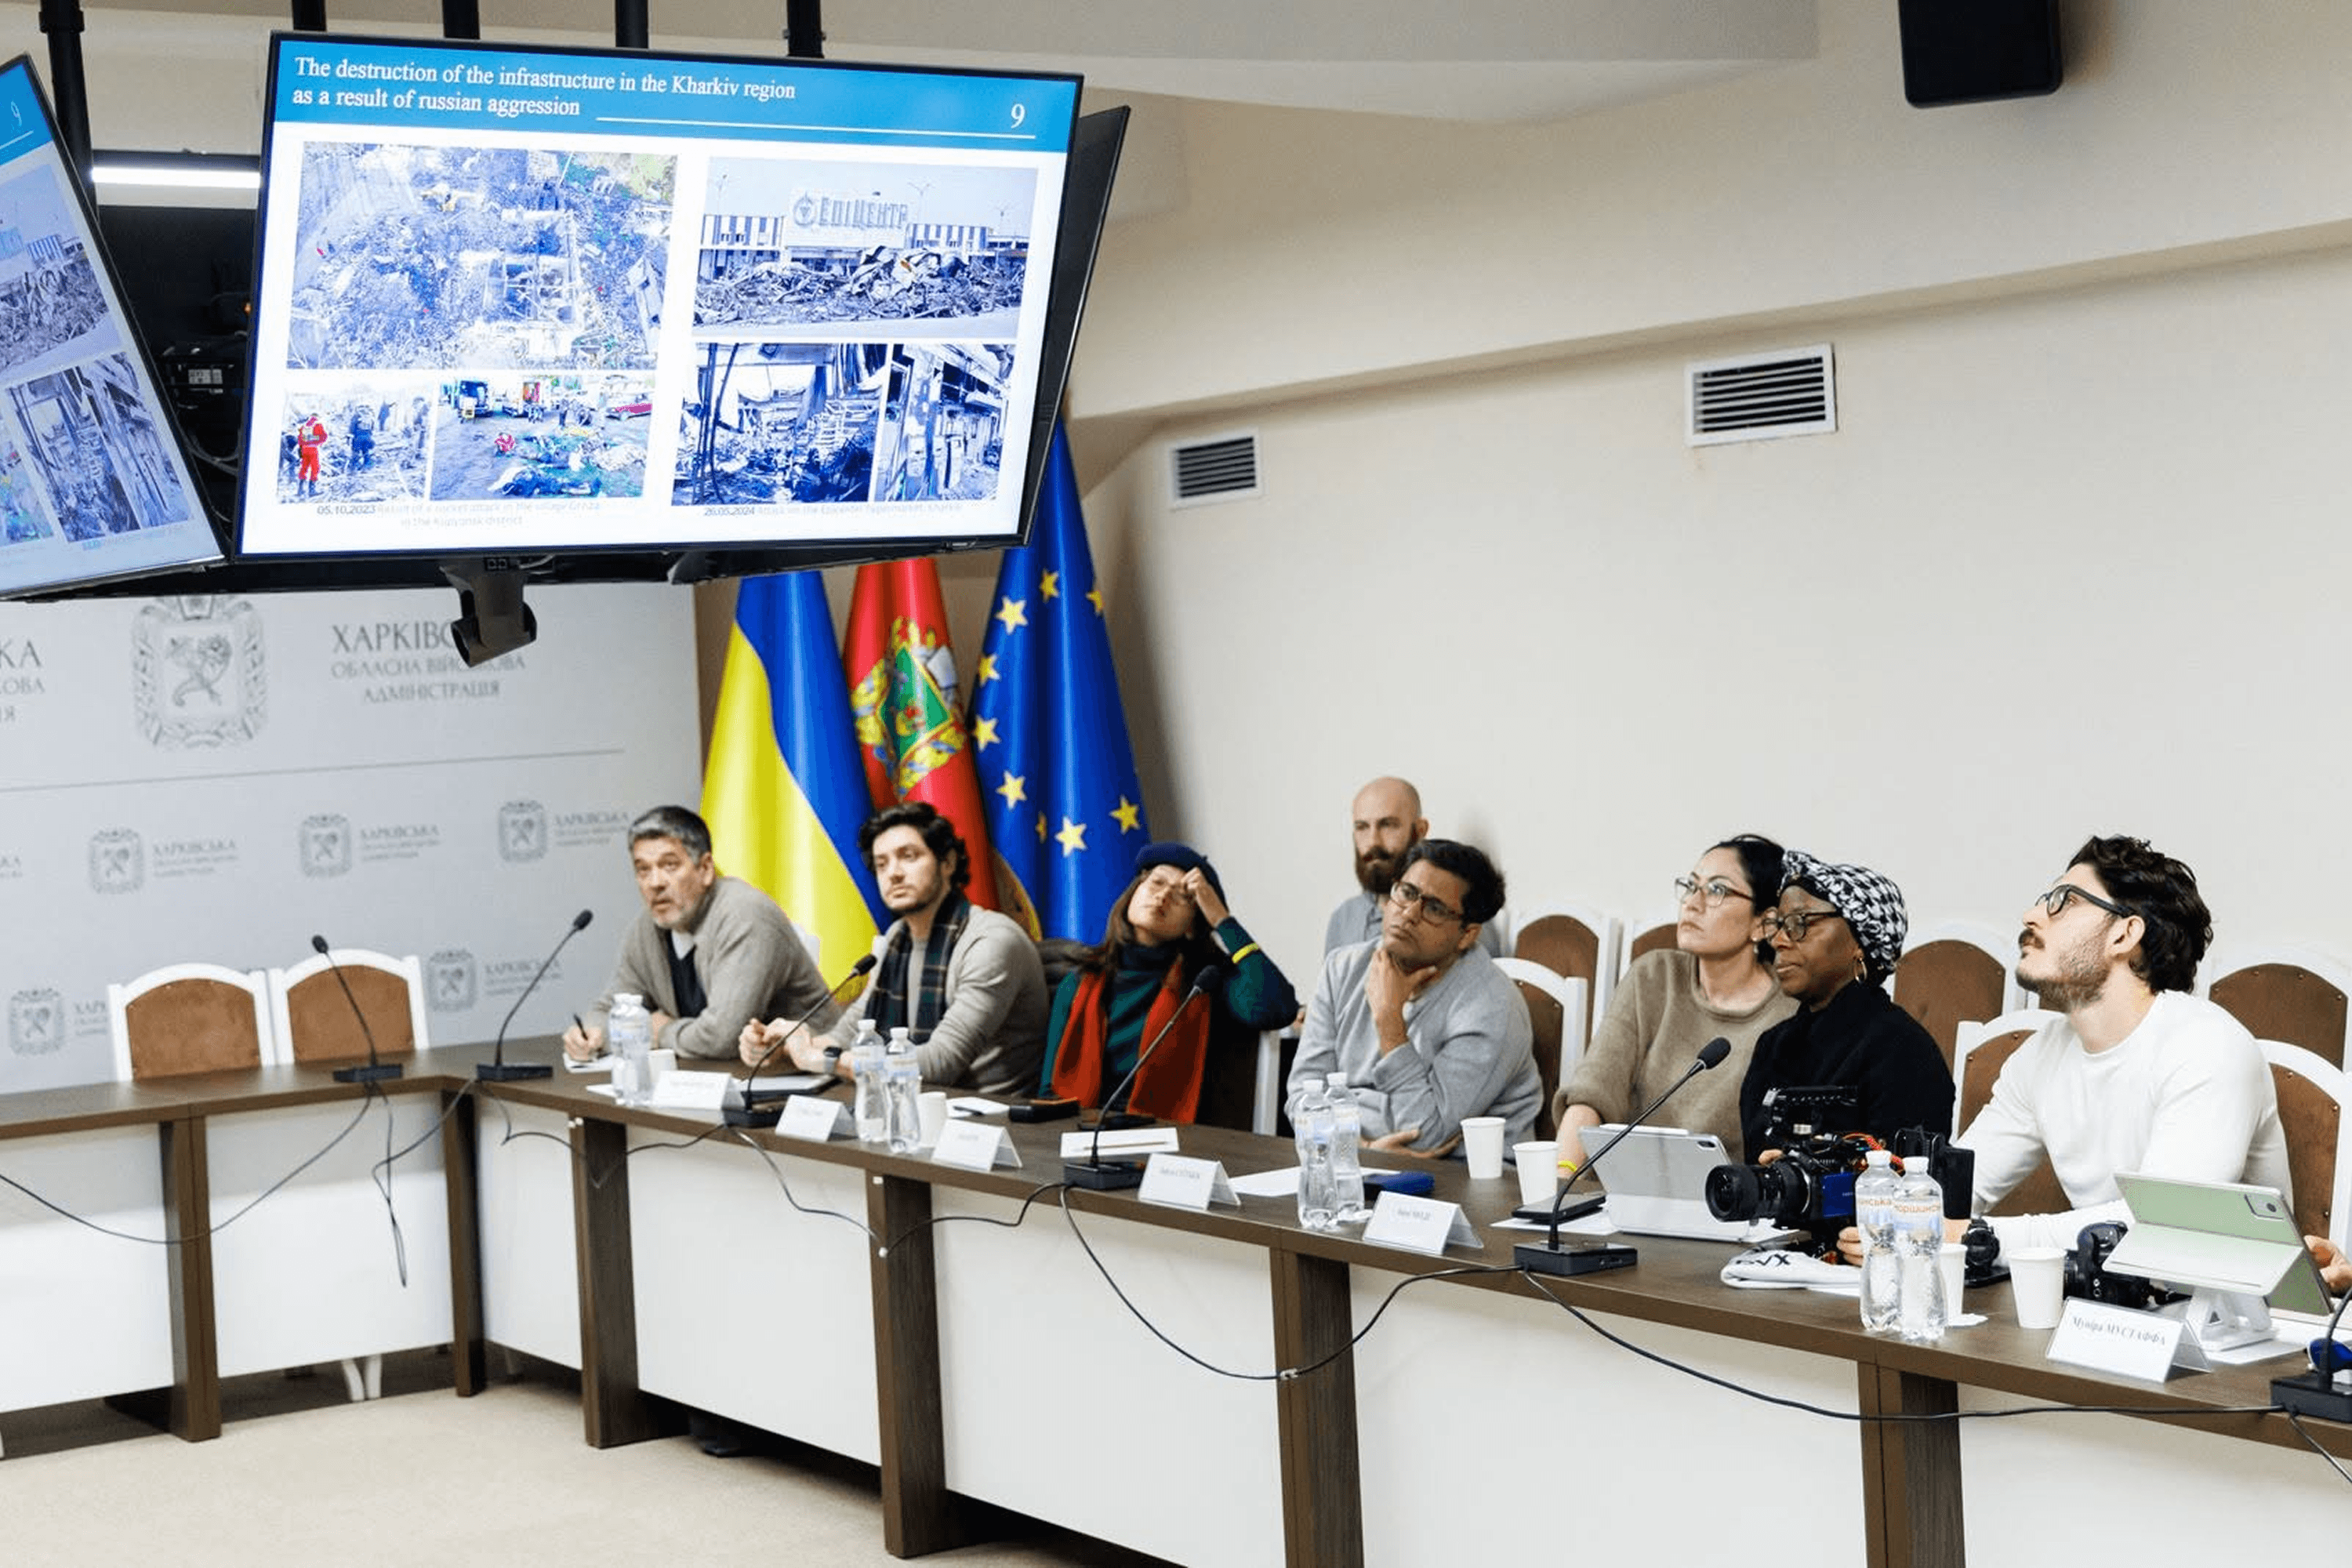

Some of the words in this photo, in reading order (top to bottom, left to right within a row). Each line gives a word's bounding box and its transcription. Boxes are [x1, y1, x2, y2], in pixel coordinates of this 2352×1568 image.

[295, 56, 331, 77] The
[336, 58, 437, 82] destruction
[442, 64, 465, 82] of
[466, 65, 494, 85] the
[498, 66, 615, 90] infrastructure
[619, 71, 636, 91] in
[641, 74, 667, 93] the
[671, 75, 739, 96] Kharkiv
[744, 79, 796, 102] region
[10, 100, 23, 127] 9
[292, 89, 313, 105] as
[318, 90, 330, 105] a
[336, 88, 388, 107] result
[393, 89, 416, 108] of
[418, 91, 482, 111] russian
[487, 95, 580, 118] aggression
[1010, 103, 1026, 129] 9
[317, 504, 376, 516] 05.10.2023
[332, 619, 455, 654] ХАРКІВС
